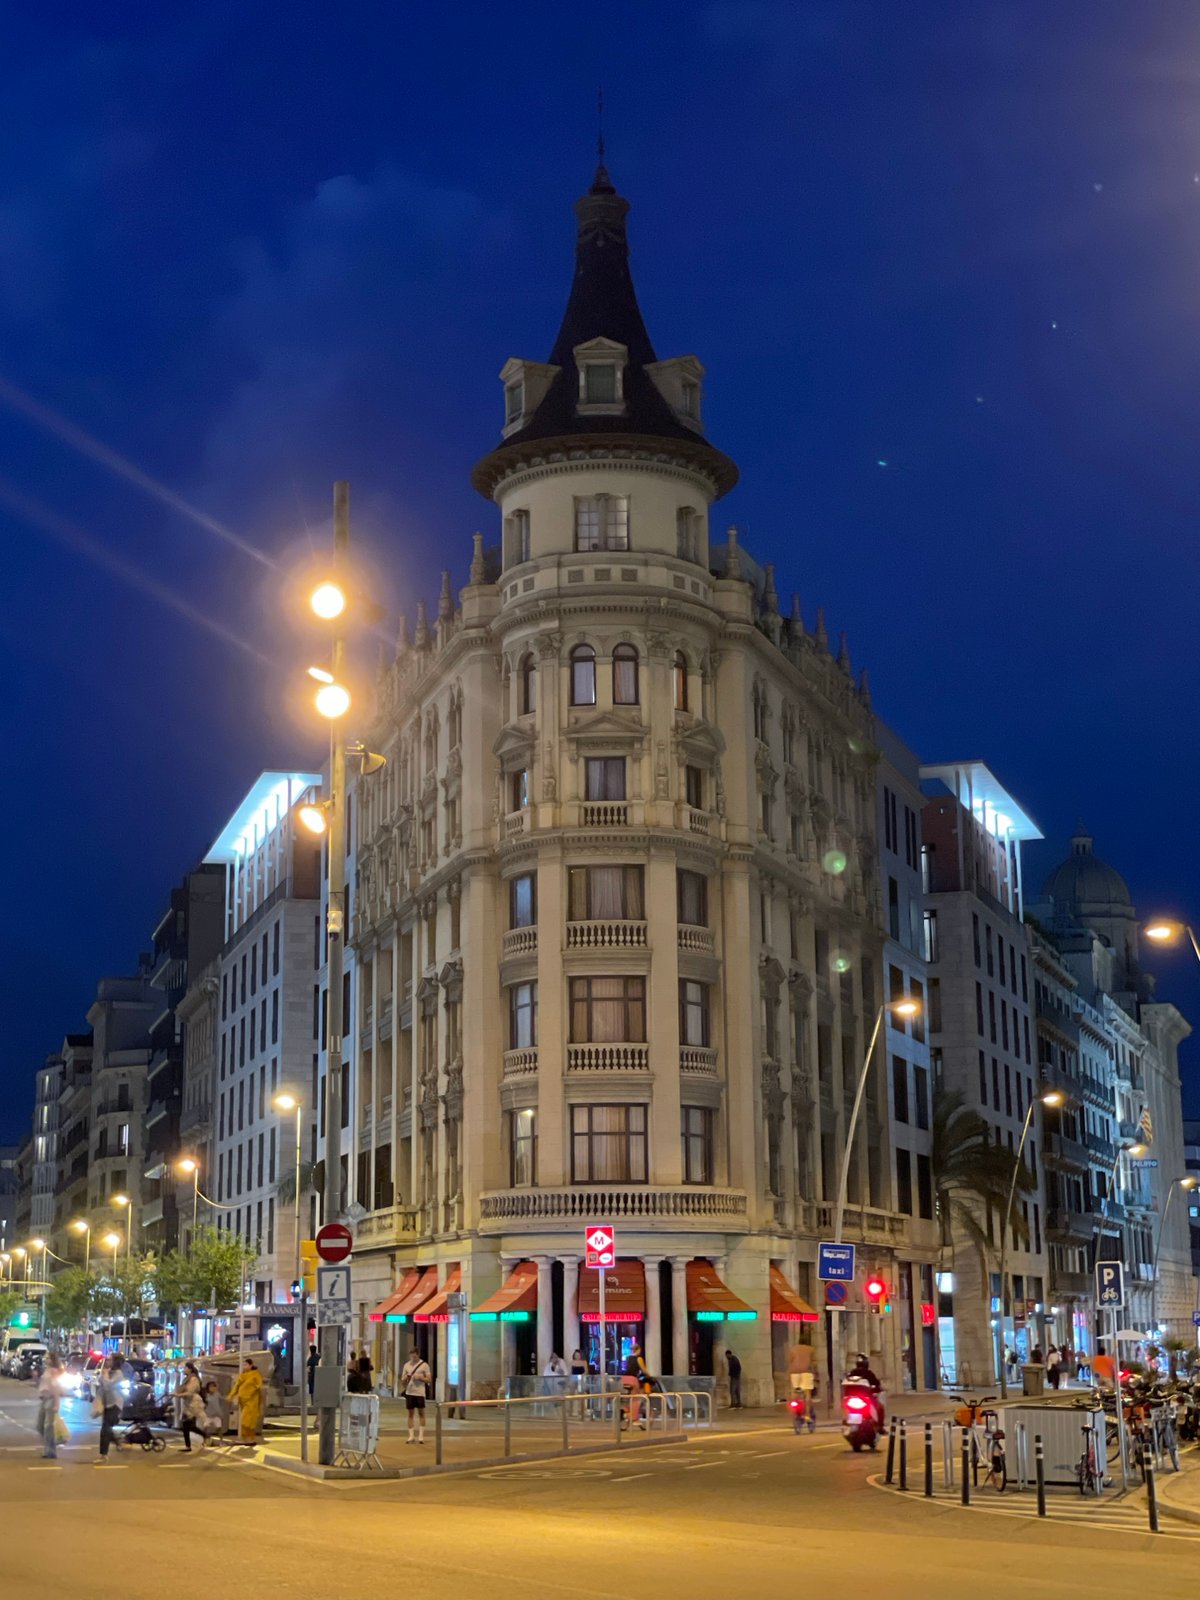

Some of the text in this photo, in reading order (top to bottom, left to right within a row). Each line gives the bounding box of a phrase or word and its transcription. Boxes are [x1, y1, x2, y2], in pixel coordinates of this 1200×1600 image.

[595, 1236, 604, 1245] M
[829, 1267, 844, 1275] taxi
[1103, 1268, 1114, 1285] P
